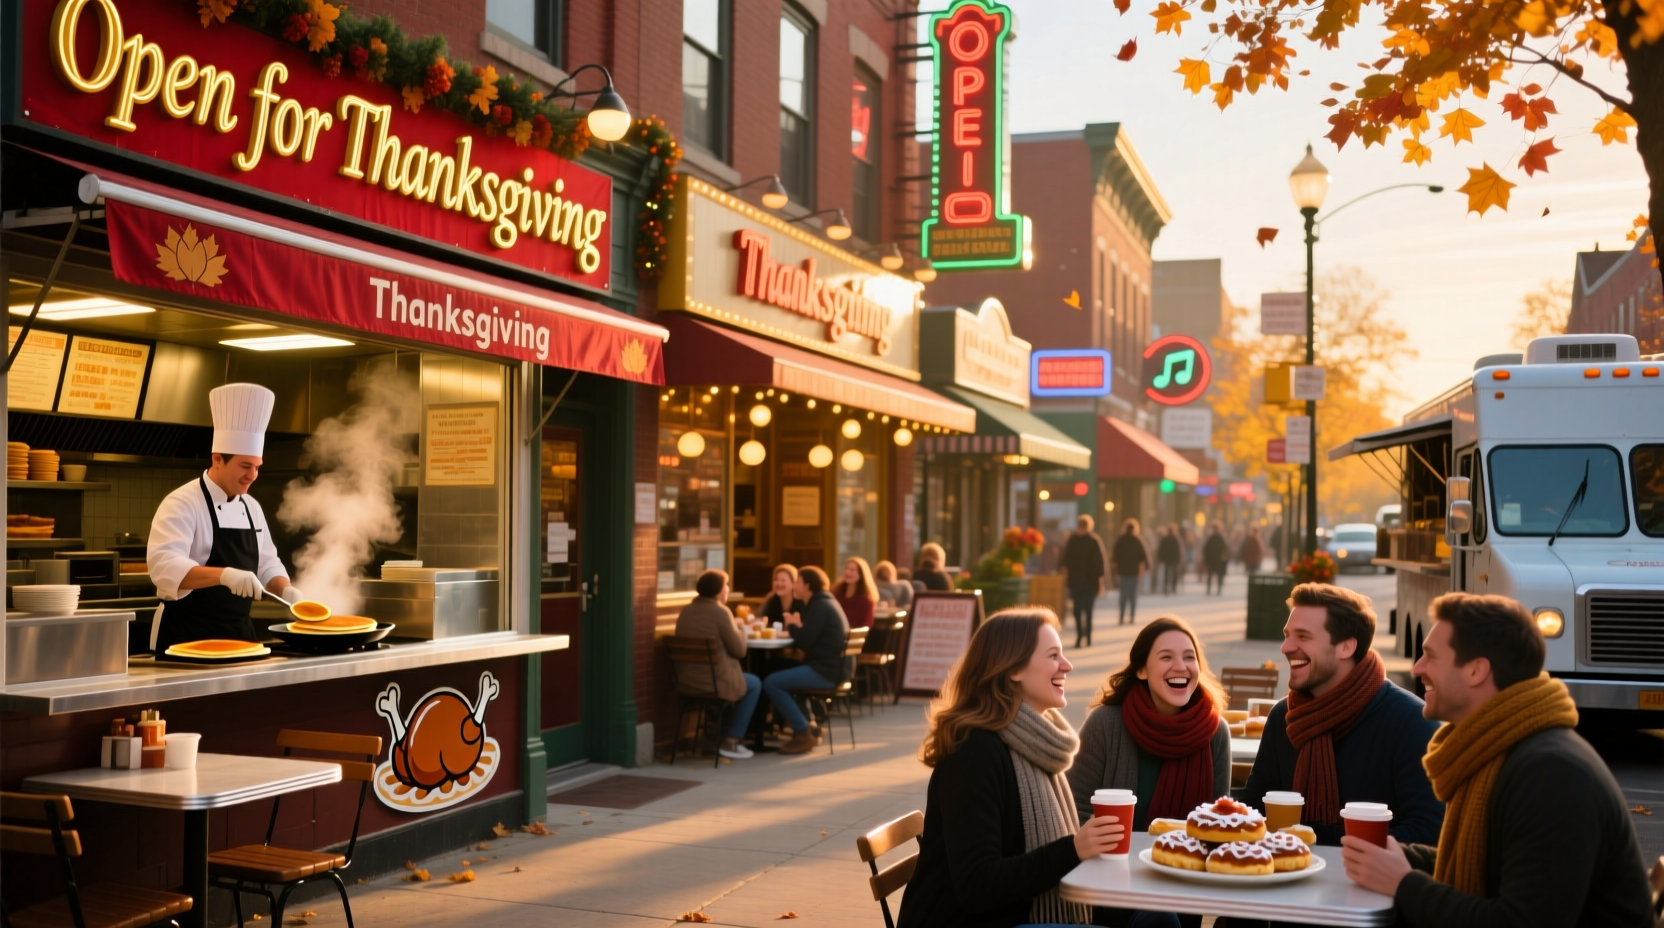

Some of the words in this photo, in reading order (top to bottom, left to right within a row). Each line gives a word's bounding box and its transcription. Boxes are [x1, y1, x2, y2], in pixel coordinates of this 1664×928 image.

[51, 0, 238, 133] Open
[236, 61, 333, 172] for
[339, 94, 607, 275] Thanksgiving
[371, 279, 551, 360] Thanksgiving
